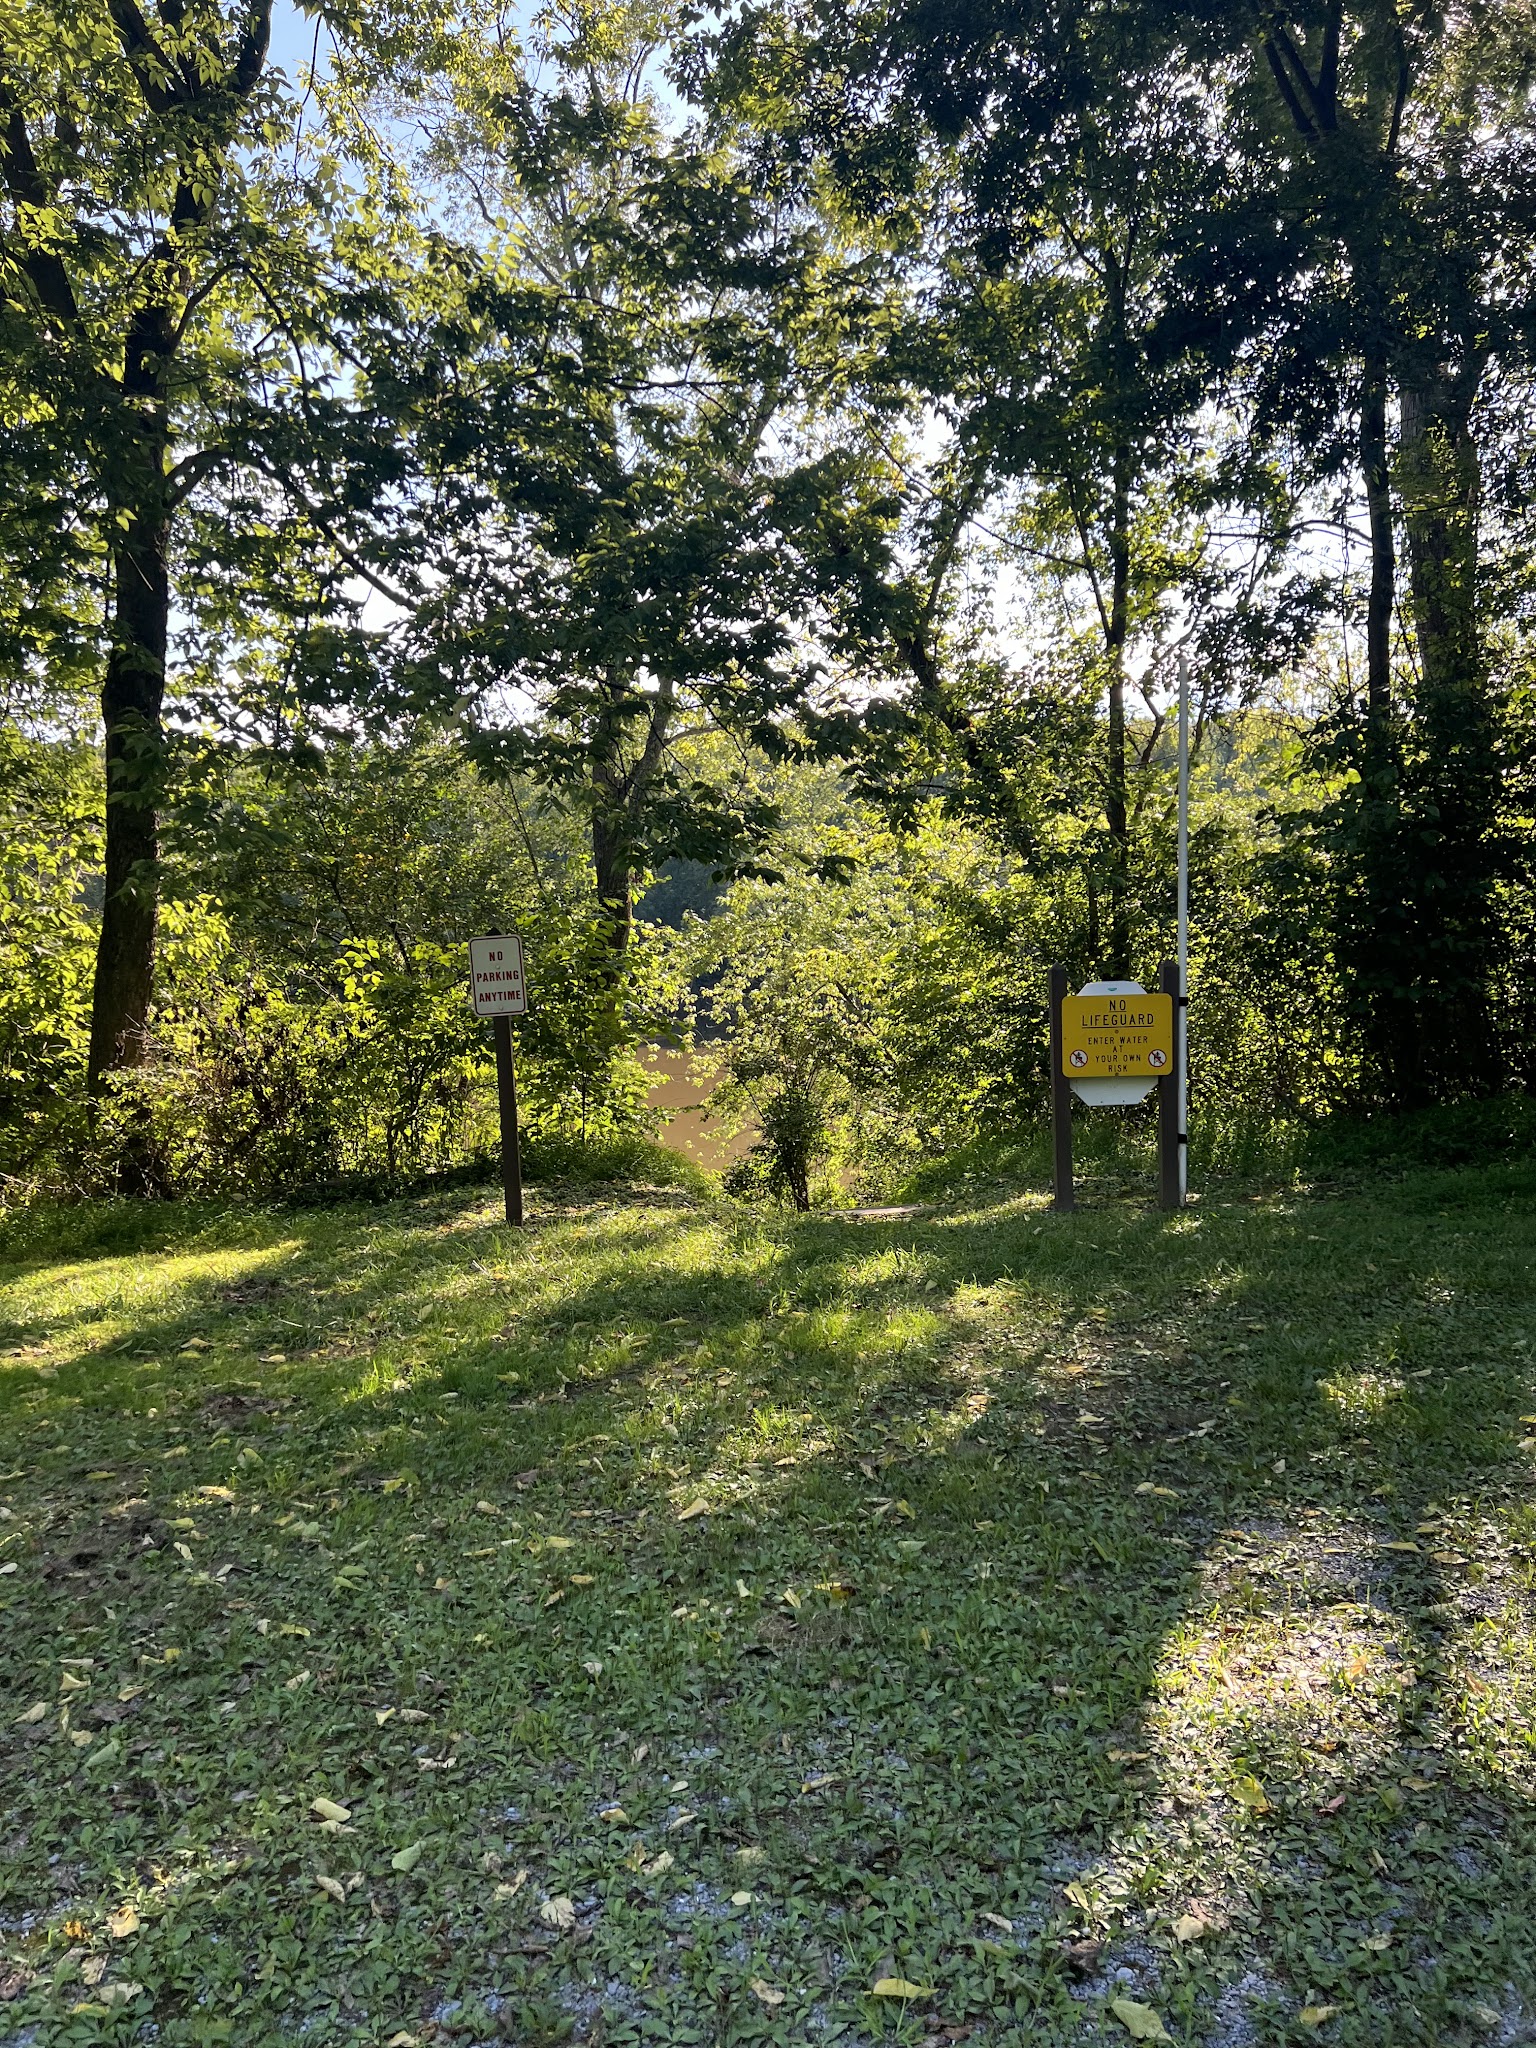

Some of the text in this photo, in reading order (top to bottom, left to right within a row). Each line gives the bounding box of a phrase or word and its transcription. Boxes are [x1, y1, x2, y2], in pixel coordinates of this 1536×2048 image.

[489, 951, 503, 962] NO
[476, 970, 520, 983] PARKING
[479, 990, 522, 1003] ANYTIME
[1109, 1000, 1127, 1011] NO
[1081, 1014, 1155, 1026] LIFEGUARD
[1088, 1036, 1148, 1045] ENTER WATER
[1112, 1045, 1123, 1053] AT
[1095, 1054, 1141, 1063] YOUR OWN
